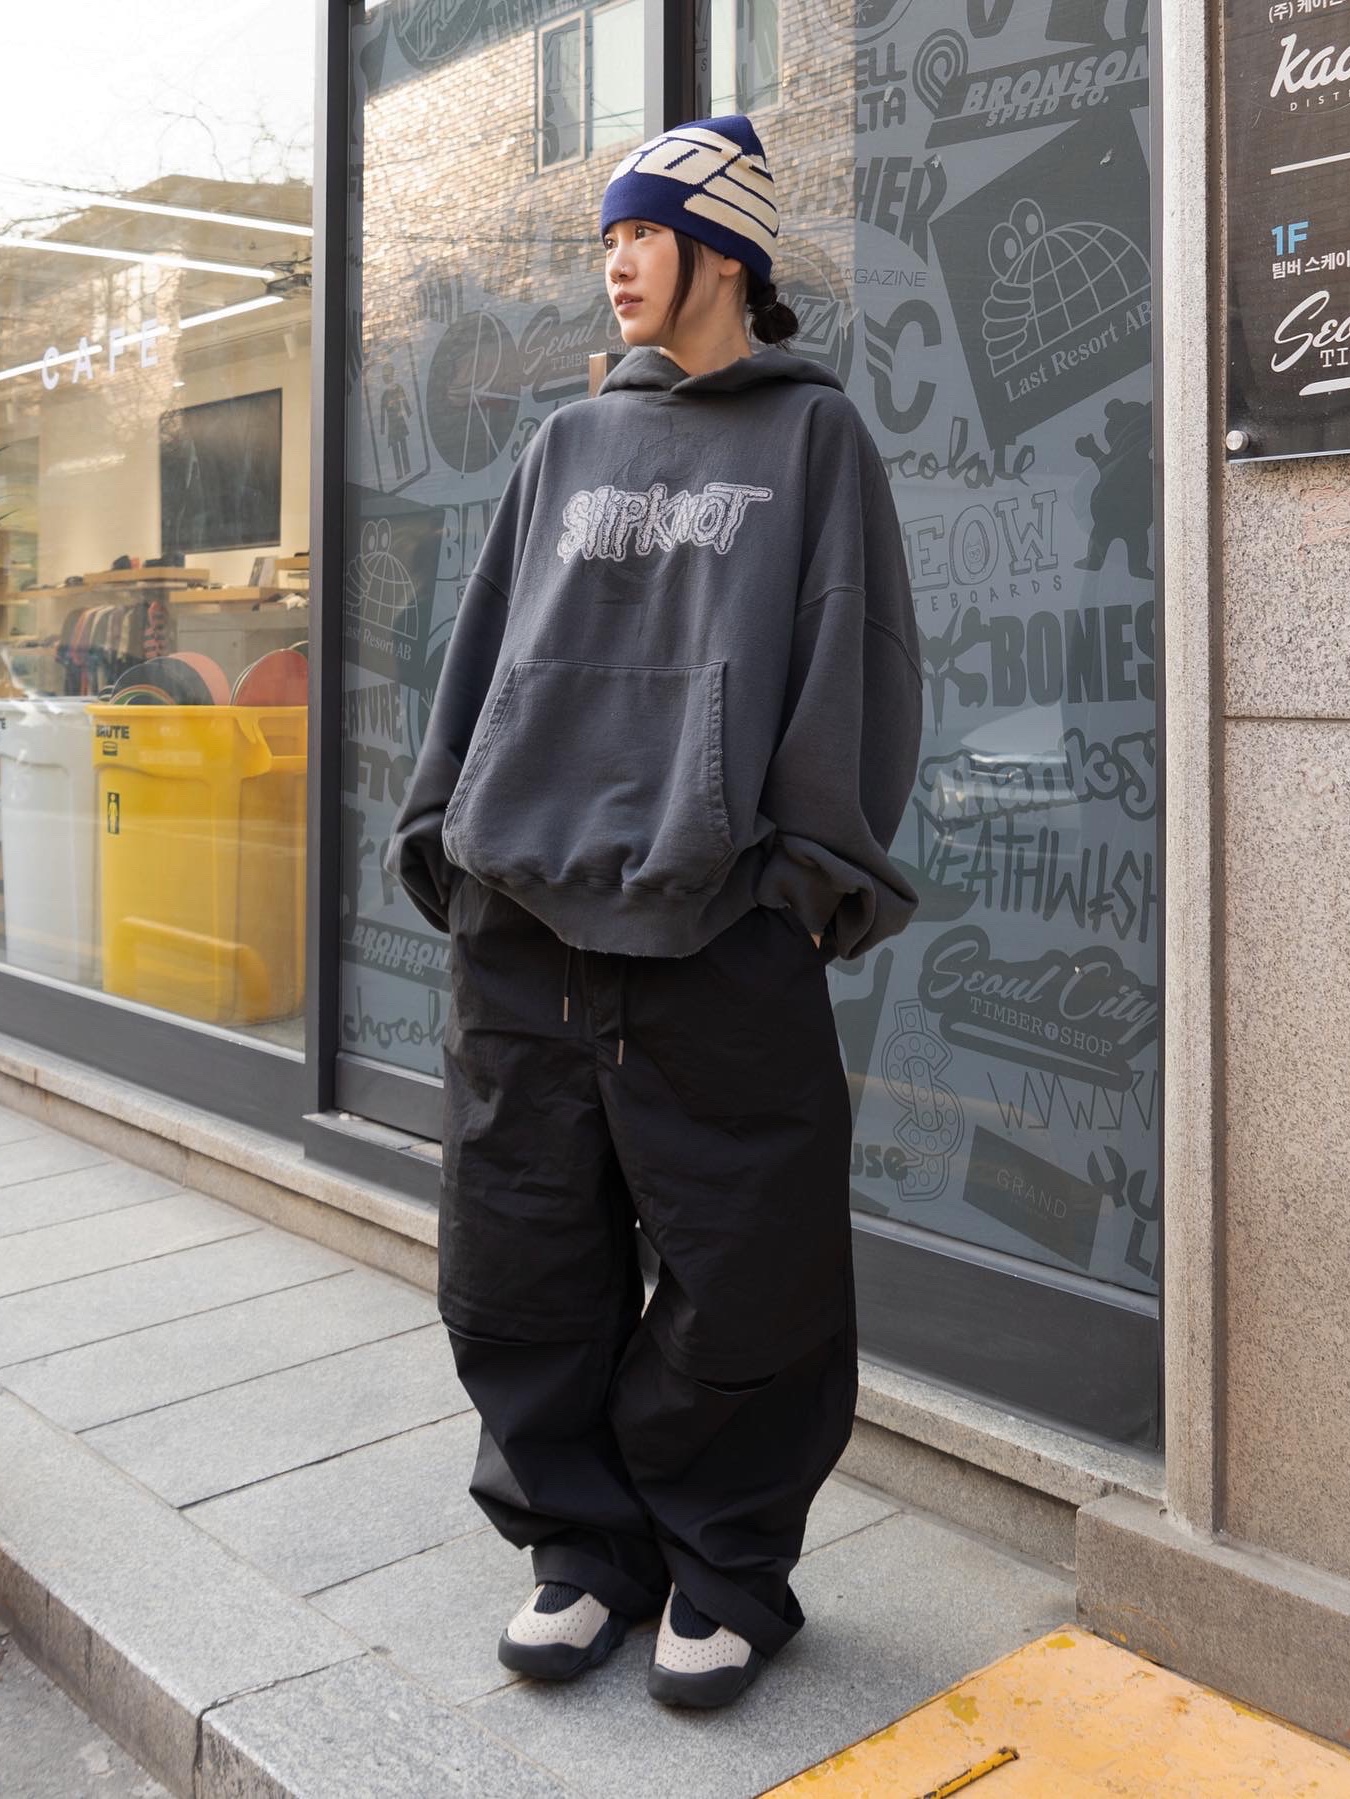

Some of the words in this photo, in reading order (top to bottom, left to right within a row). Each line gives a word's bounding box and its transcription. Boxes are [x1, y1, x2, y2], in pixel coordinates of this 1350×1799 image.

[1290, 91, 1350, 112] DIST
[1271, 221, 1309, 256] 1F
[1272, 258, 1301, 280] 팀버
[41, 319, 158, 390] CAFE
[523, 304, 605, 376] Seoul
[1004, 362, 1050, 402] Last
[1050, 320, 1120, 377] Resort
[1124, 300, 1152, 336] AB
[396, 640, 412, 661] AB
[342, 682, 403, 745] ATURE
[928, 939, 1062, 1004] Seoul
[343, 985, 446, 1050] chocol
[970, 996, 1043, 1036] TIMBER
[1059, 1028, 1113, 1057] SHOP
[996, 1168, 1068, 1219] GRAND
